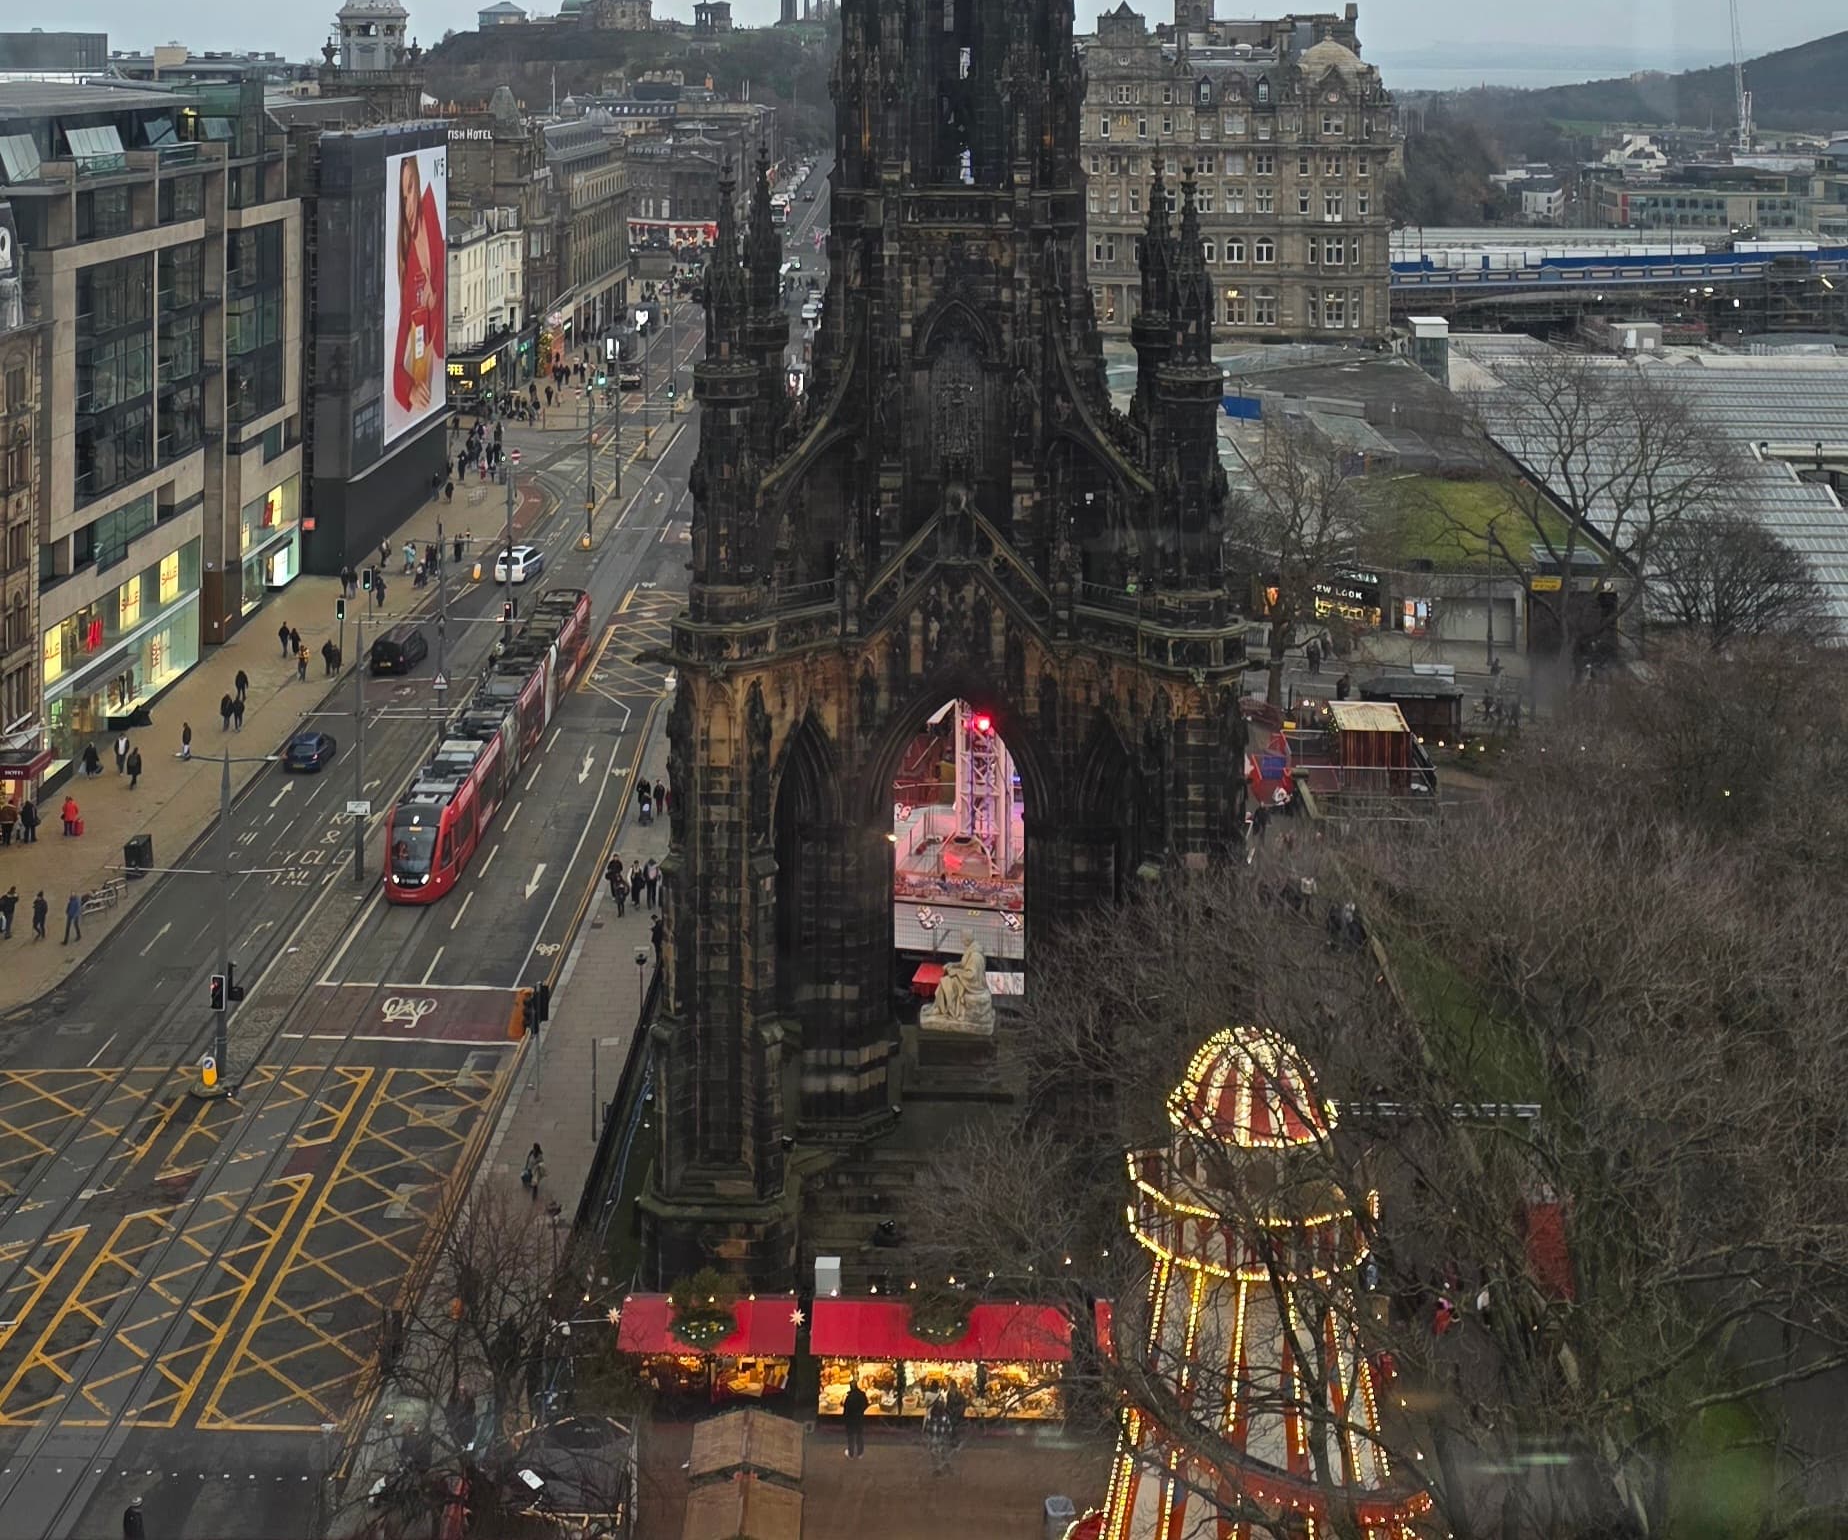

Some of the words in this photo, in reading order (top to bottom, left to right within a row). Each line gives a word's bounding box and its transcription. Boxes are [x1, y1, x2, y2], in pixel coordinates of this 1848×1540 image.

[467, 128, 493, 140] HOTEL
[1335, 587, 1363, 600] LOOK
[319, 829, 341, 845] &
